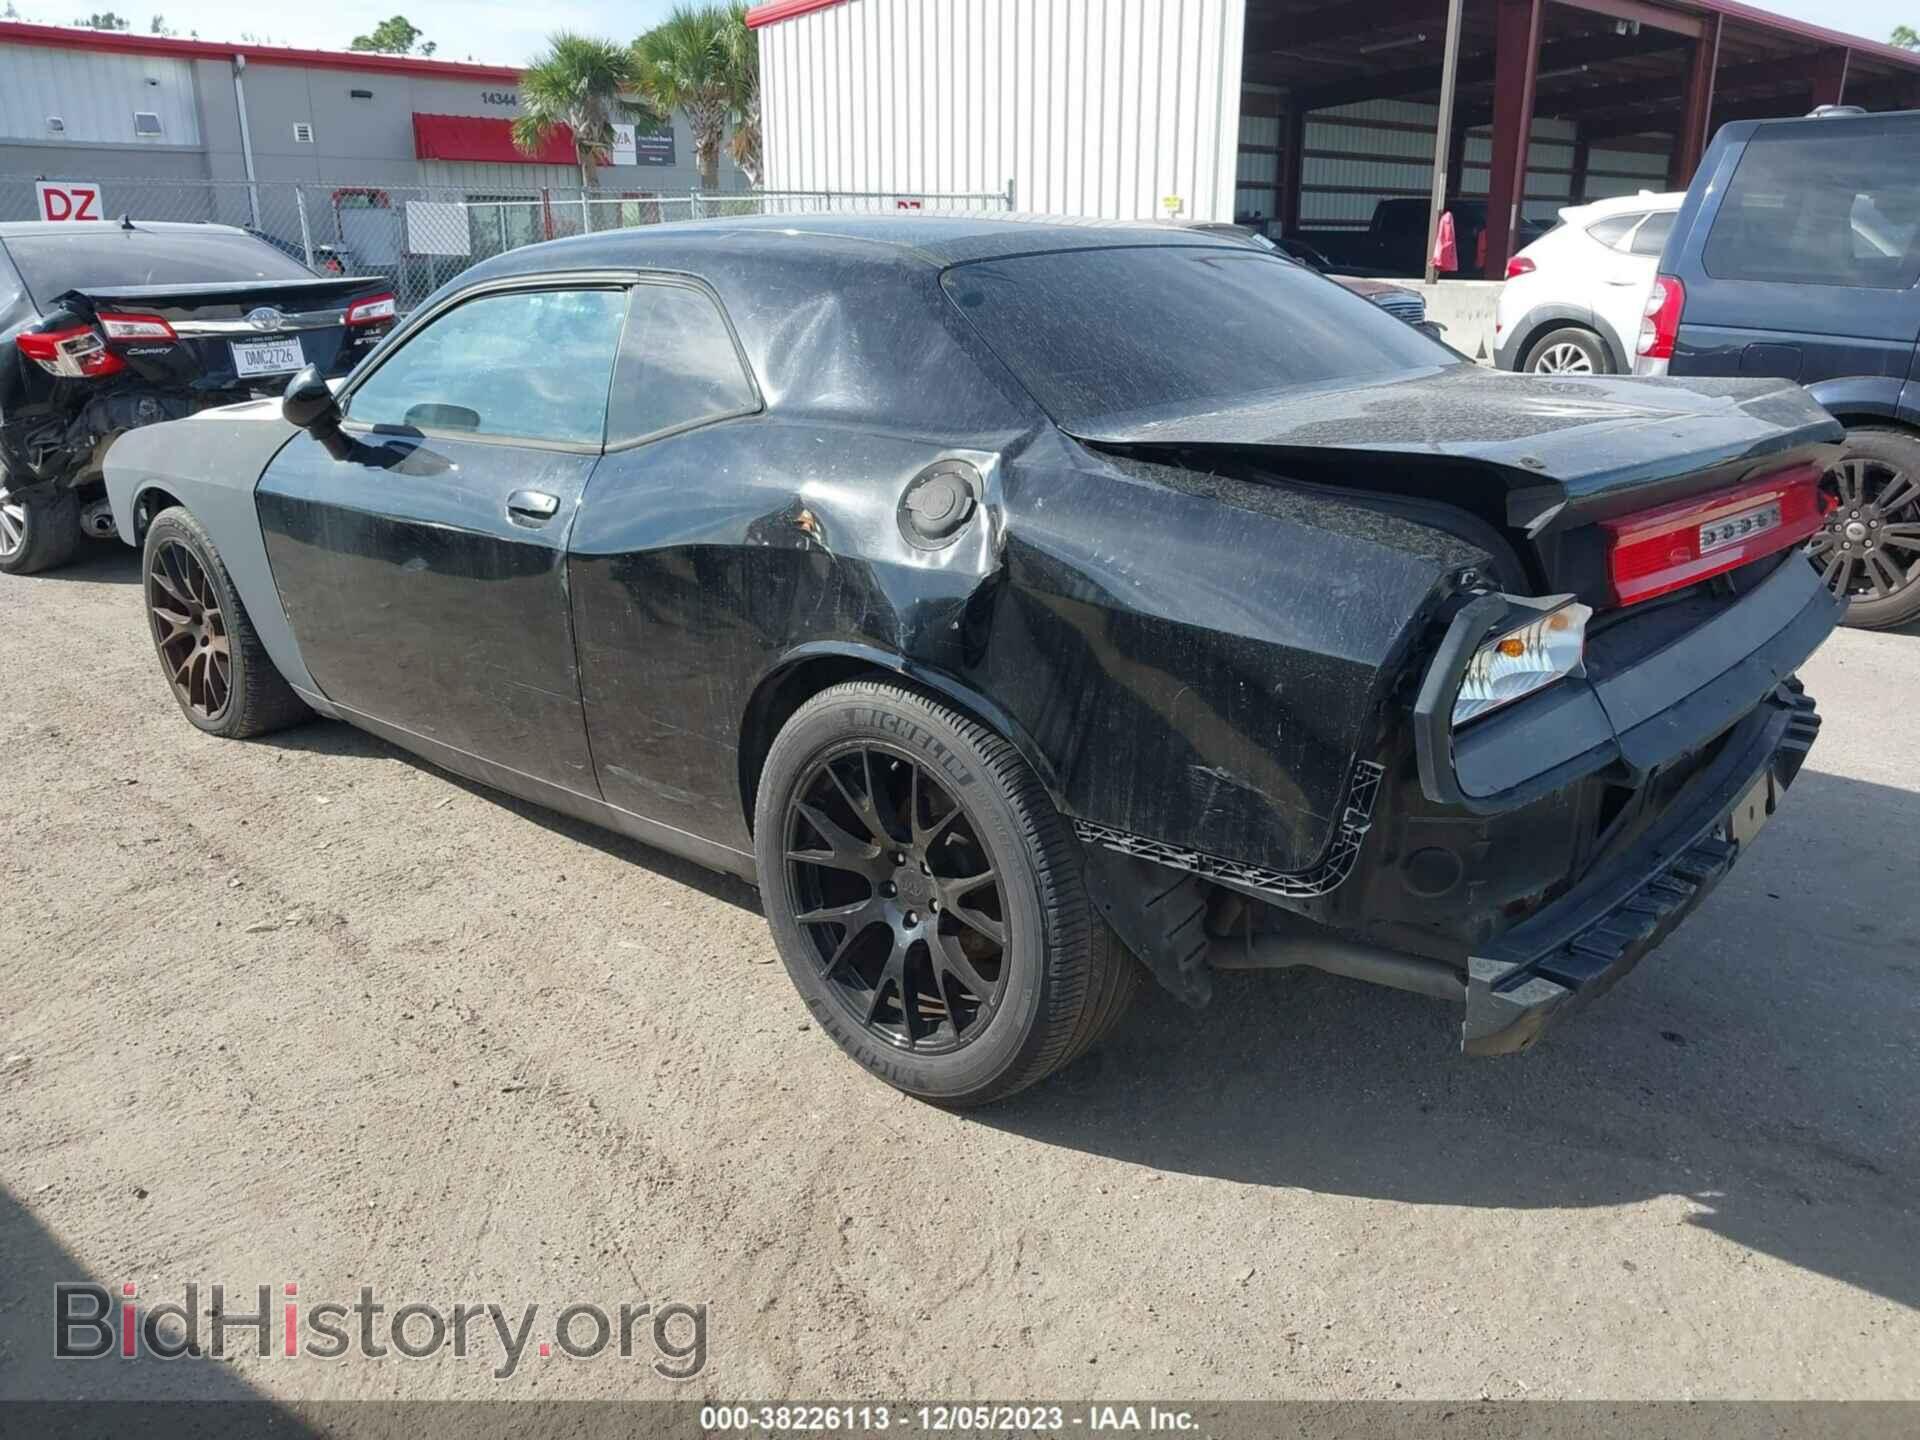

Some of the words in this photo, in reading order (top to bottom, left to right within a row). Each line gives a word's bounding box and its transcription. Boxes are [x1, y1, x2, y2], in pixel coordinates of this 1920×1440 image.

[481, 92, 516, 106] 14344
[43, 189, 98, 221] DZ
[852, 709, 975, 786] MICHELIN
